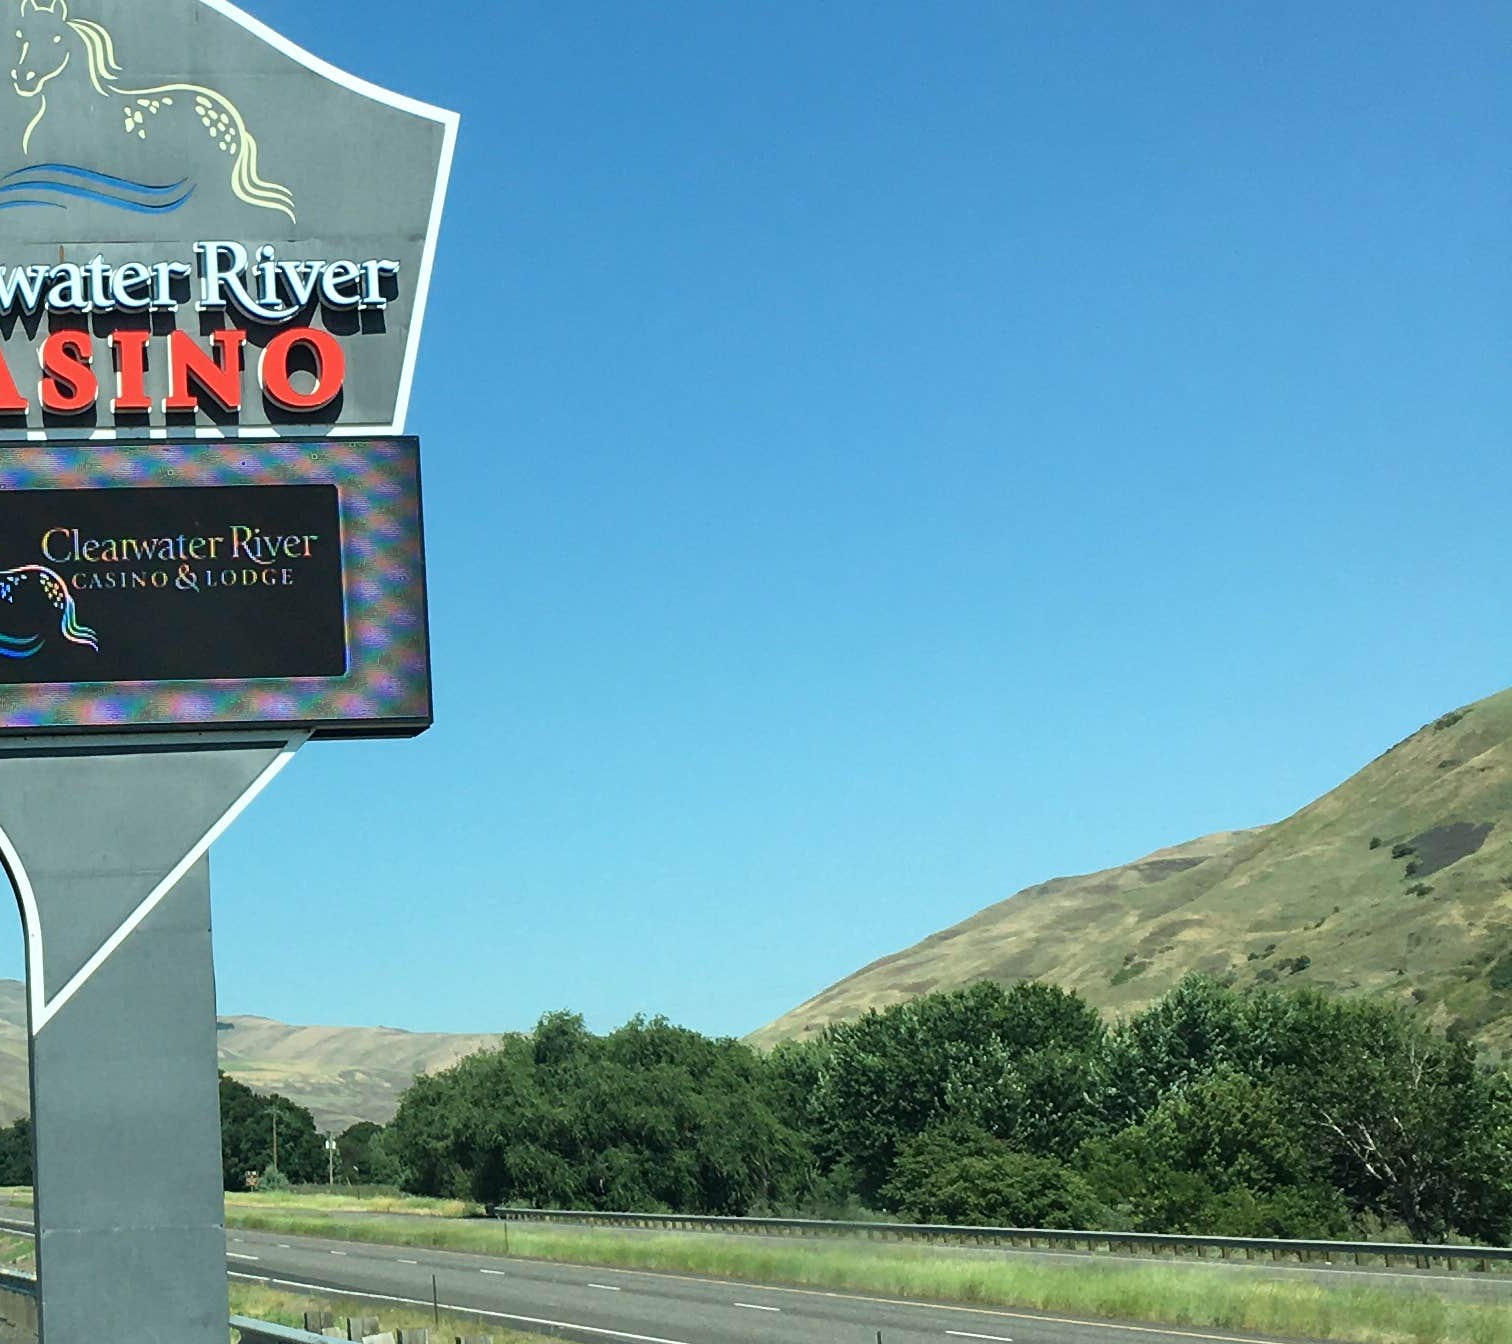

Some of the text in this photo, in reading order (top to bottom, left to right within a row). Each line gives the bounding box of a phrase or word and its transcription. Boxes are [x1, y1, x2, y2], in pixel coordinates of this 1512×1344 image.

[195, 241, 400, 324] River
[41, 525, 318, 565] Clearwater River
[71, 563, 294, 593] CASINO & LODGE
